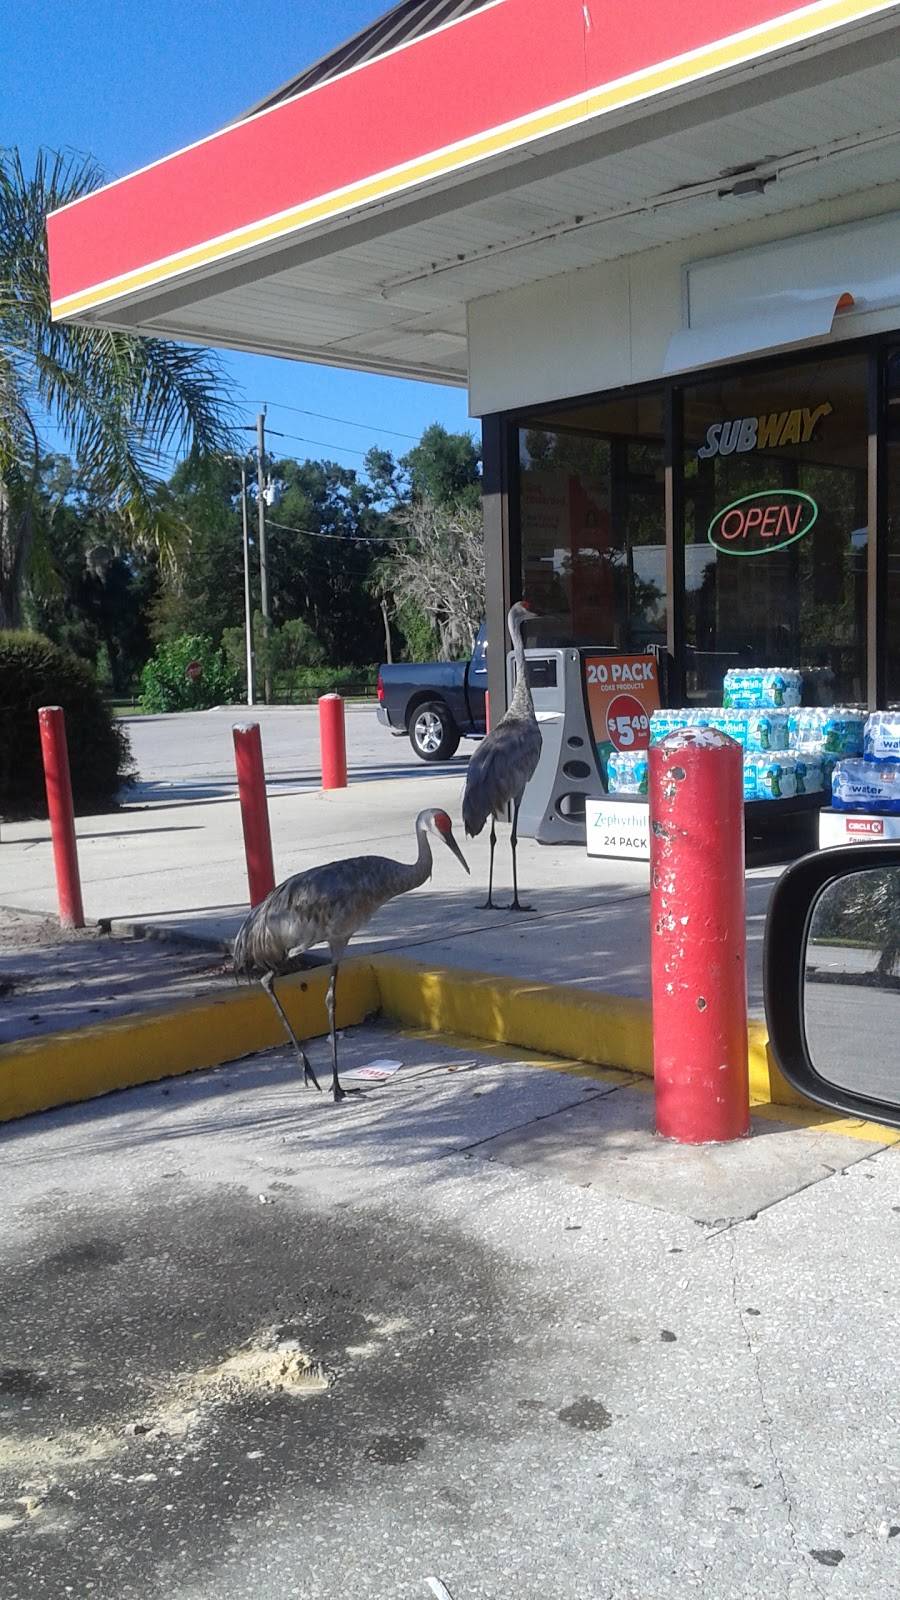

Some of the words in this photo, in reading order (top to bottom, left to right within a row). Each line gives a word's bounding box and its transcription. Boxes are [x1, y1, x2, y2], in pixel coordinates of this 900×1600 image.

[697, 401, 833, 460] SUBWAY
[720, 504, 803, 540] OPEN
[587, 664, 609, 684] 20
[611, 661, 654, 682] PACK
[851, 785, 884, 795] water
[604, 835, 616, 846] 24
[619, 836, 648, 848] PACK
